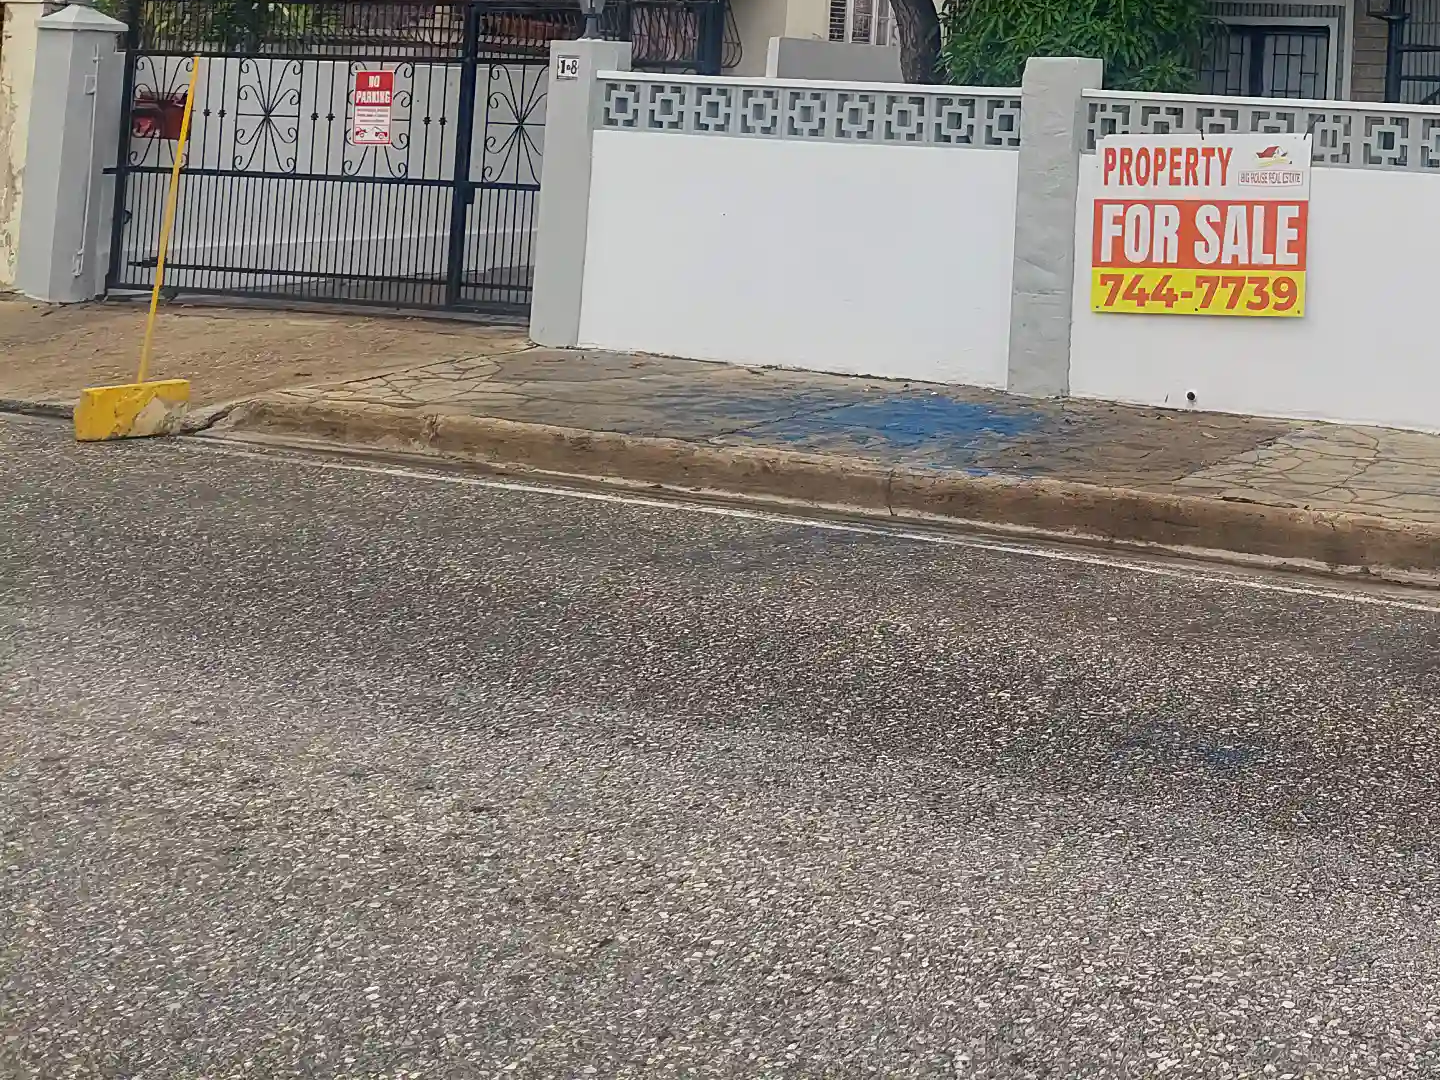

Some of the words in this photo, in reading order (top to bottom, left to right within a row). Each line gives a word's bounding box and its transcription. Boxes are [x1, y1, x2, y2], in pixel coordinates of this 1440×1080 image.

[356, 90, 391, 104] PARKING
[368, 75, 380, 88] NO
[1103, 147, 1233, 186] PROPERTY
[1101, 204, 1180, 263] FOR
[1194, 204, 1299, 265] SALE
[1100, 274, 1298, 311] 744-7739
